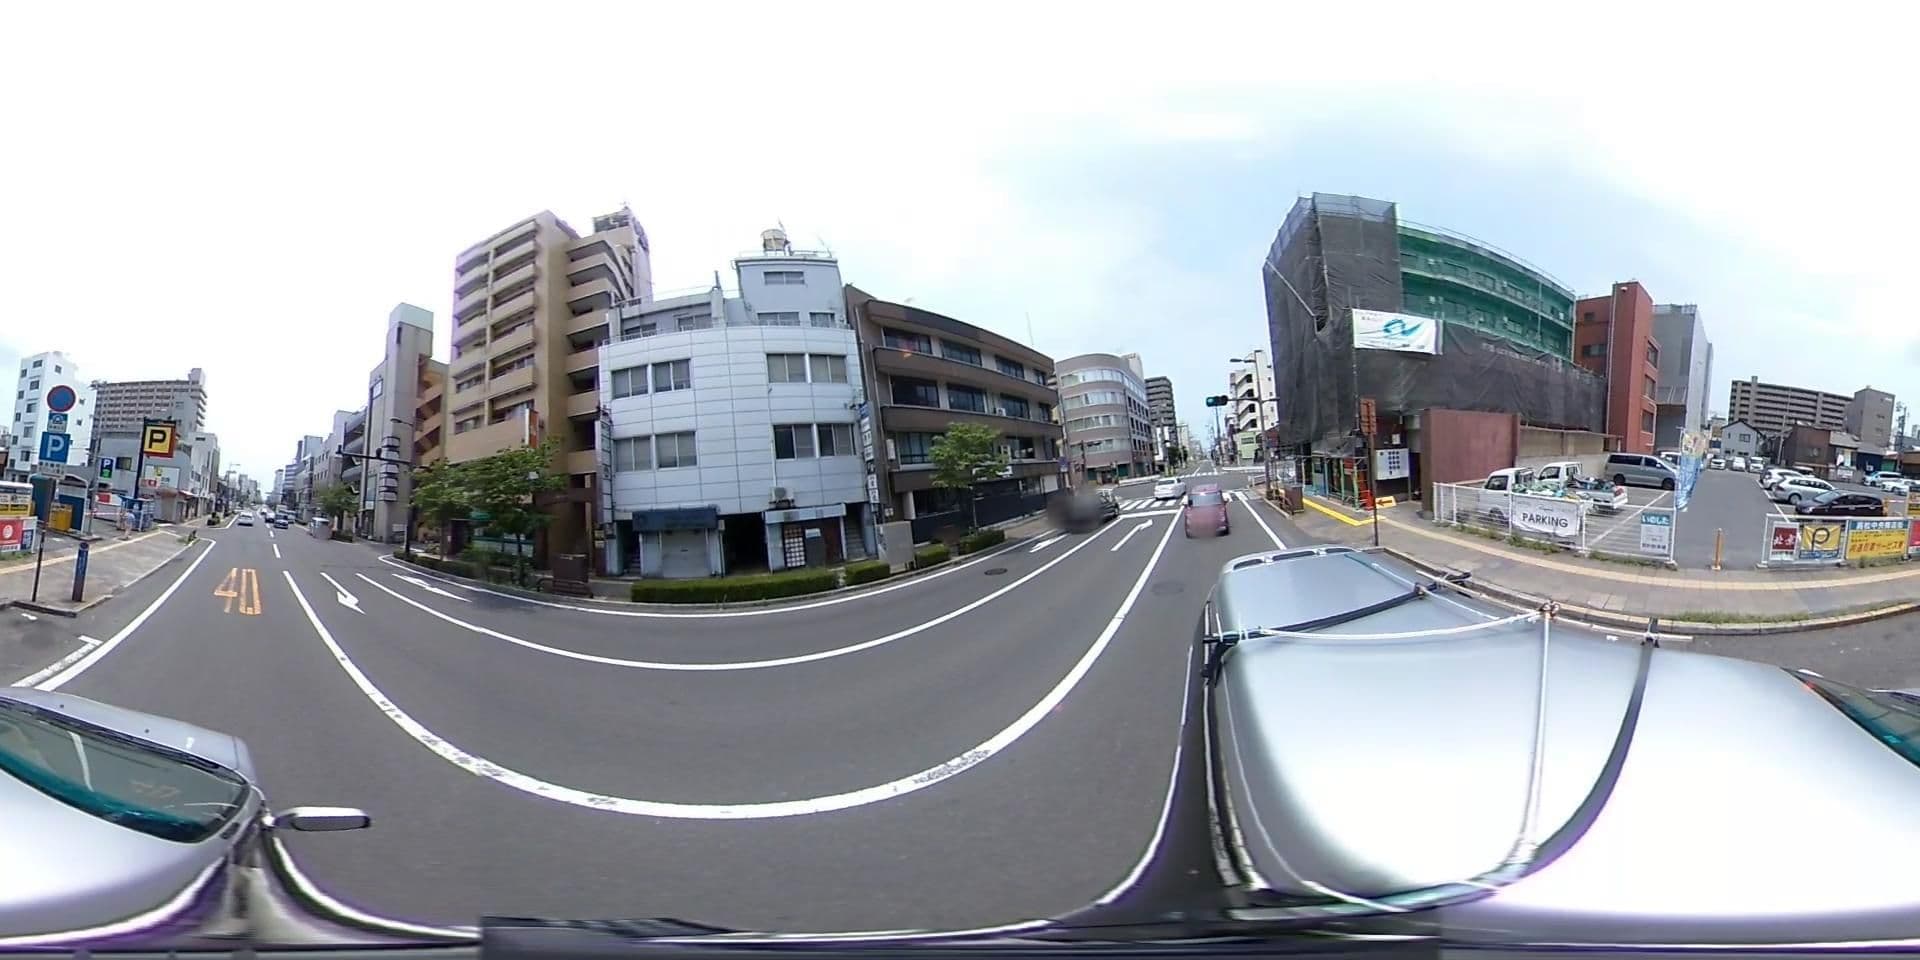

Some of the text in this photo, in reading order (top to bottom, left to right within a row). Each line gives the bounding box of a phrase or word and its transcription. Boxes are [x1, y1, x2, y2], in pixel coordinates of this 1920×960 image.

[46, 434, 65, 458] P
[148, 429, 167, 449] P
[103, 459, 110, 468] P
[1522, 512, 1569, 528] PARKING
[1811, 527, 1831, 551] P
[214, 567, 262, 616] 40
